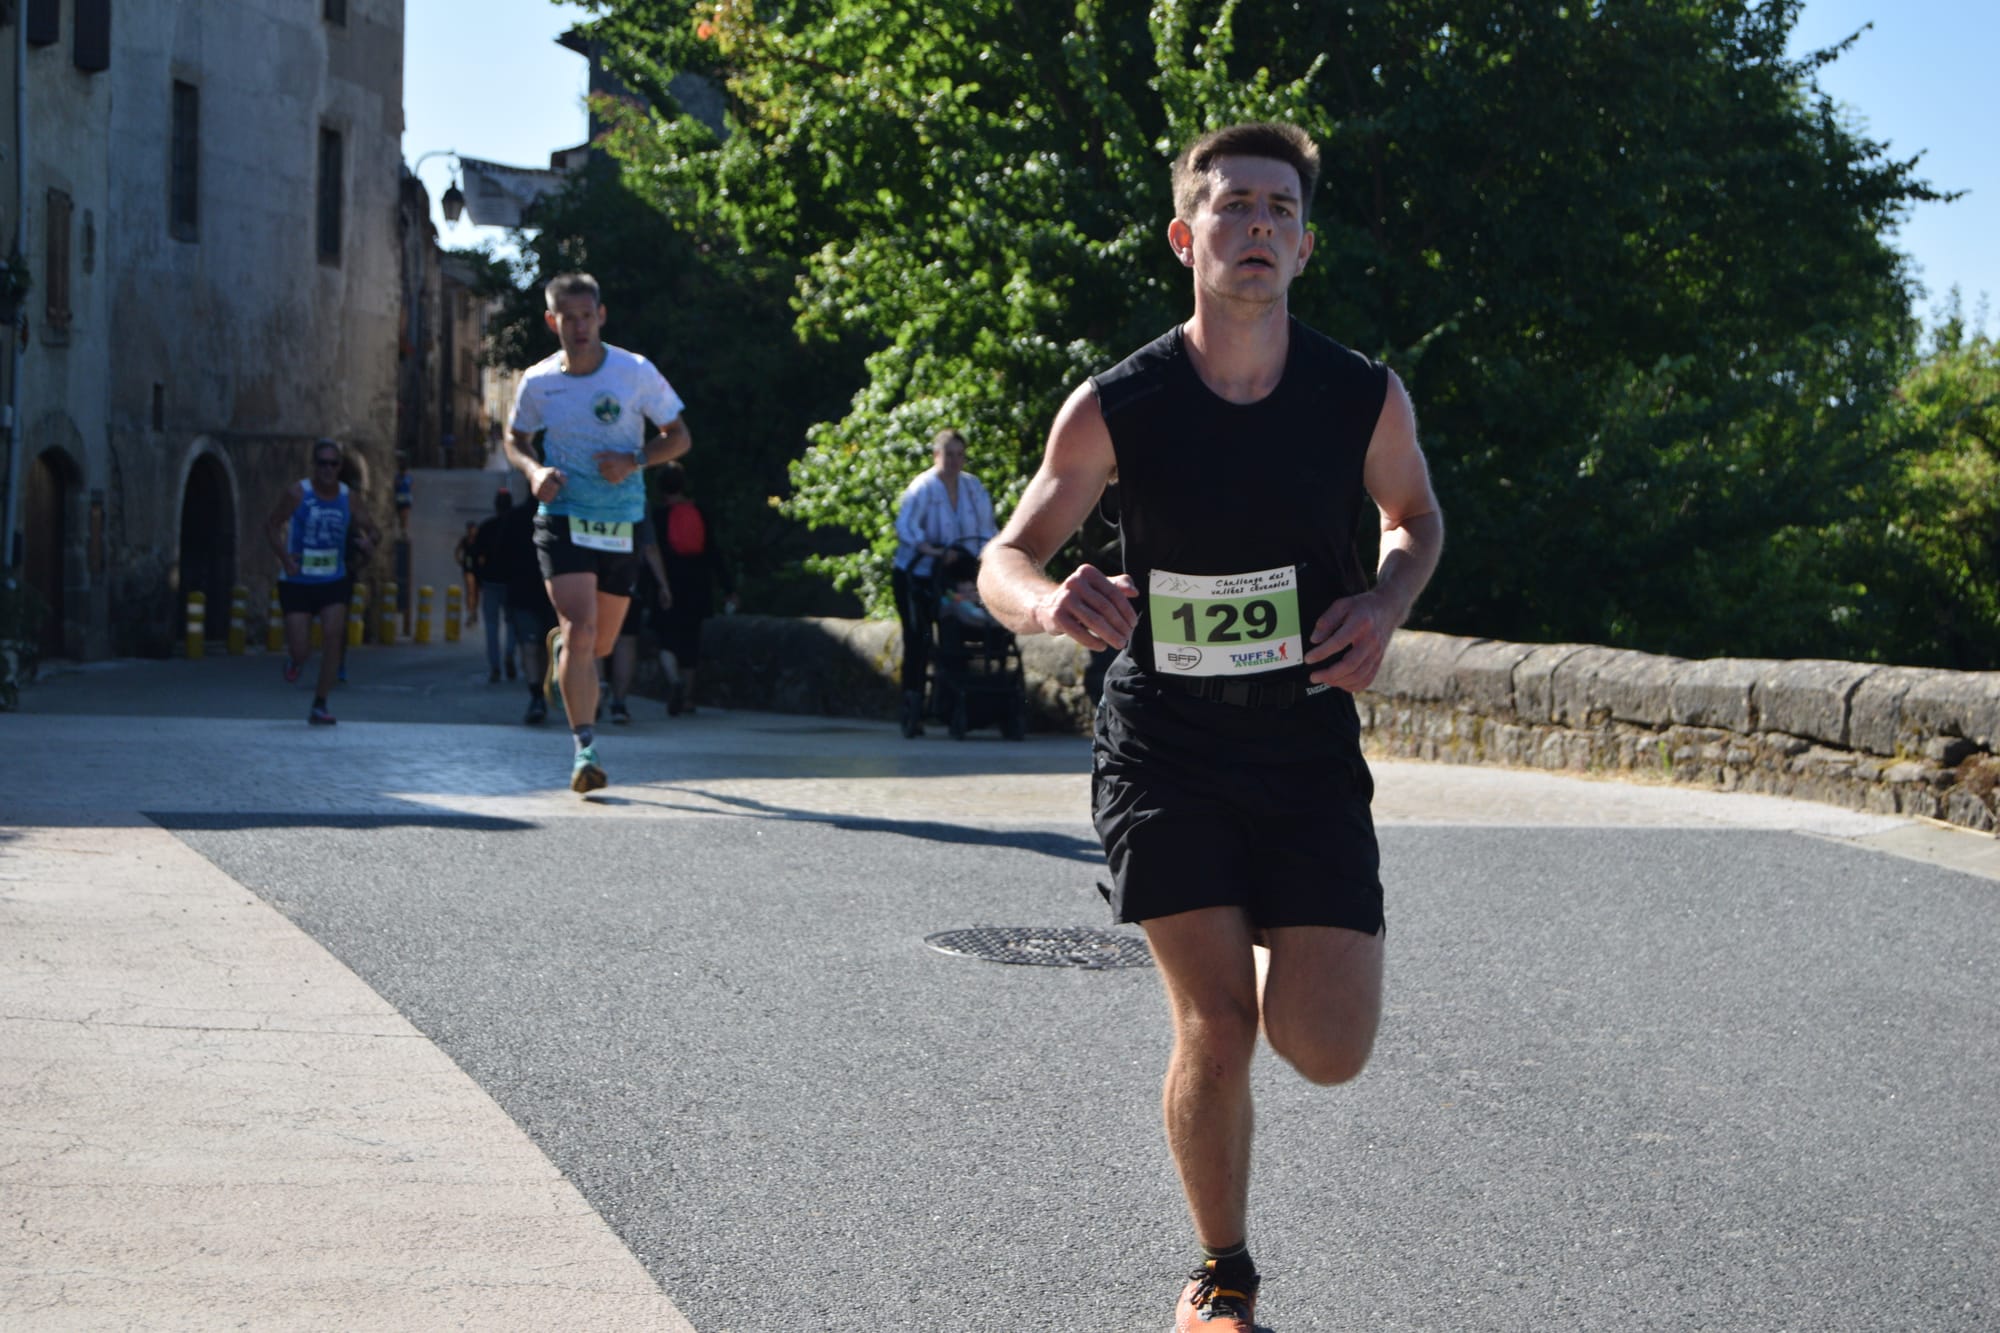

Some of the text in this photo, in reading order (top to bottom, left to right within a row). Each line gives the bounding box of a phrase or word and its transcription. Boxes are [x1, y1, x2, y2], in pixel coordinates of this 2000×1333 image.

[579, 518, 621, 536] 147
[1215, 572, 1284, 588] Challenge des
[1172, 600, 1278, 642] 129
[1230, 649, 1275, 662] TUFF'S
